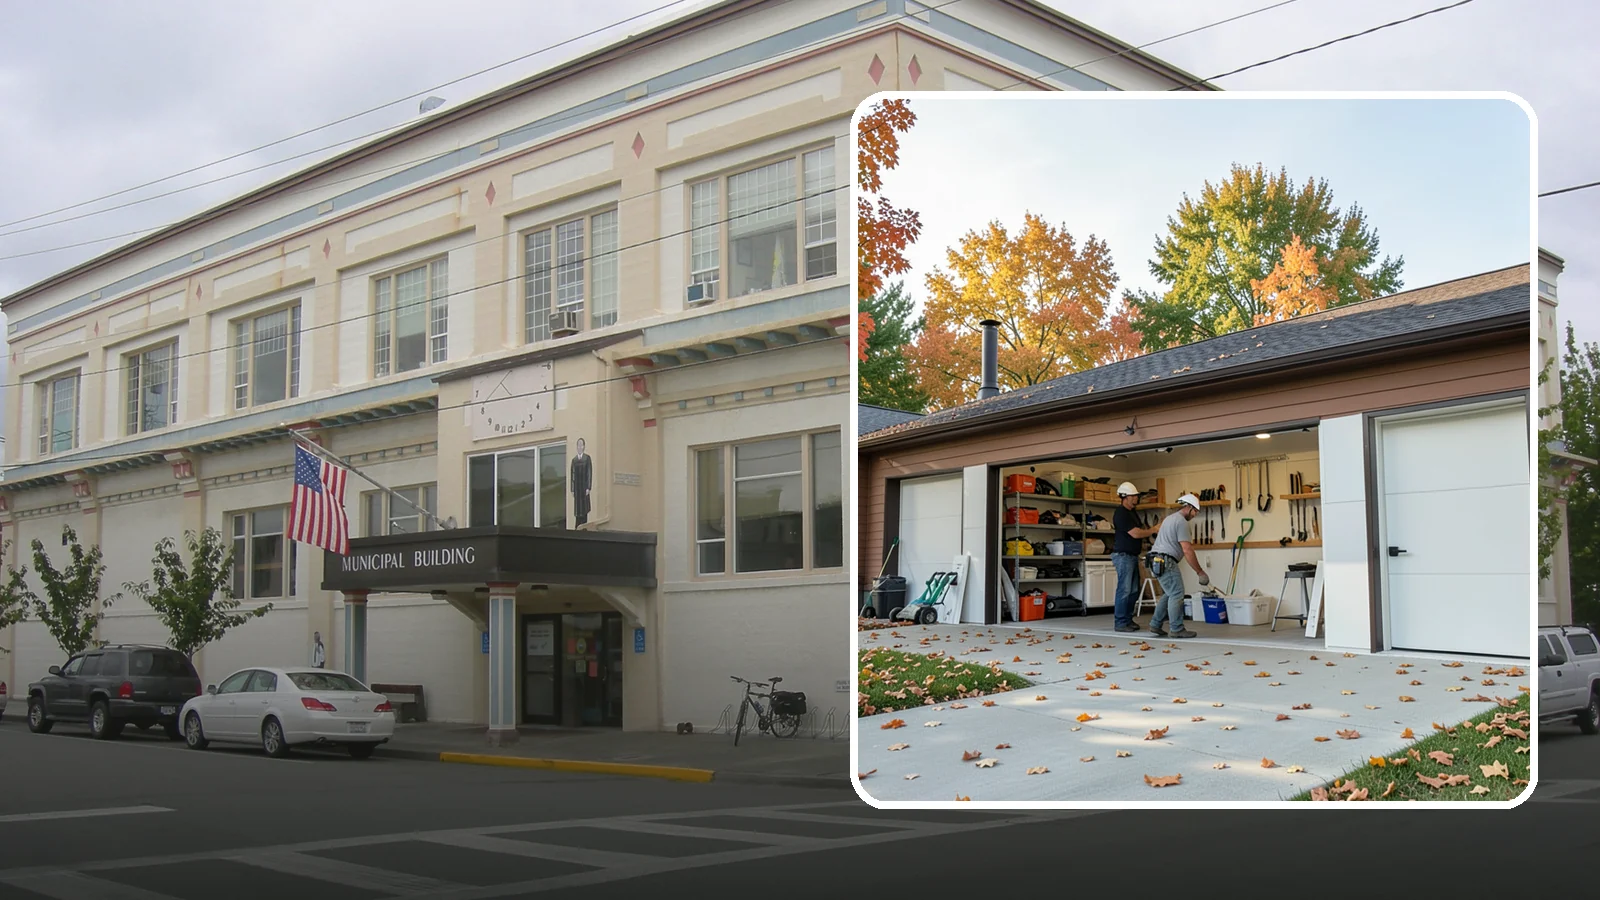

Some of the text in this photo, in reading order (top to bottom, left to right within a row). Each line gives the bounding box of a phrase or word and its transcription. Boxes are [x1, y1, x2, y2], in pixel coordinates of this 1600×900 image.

[508, 425, 513, 433] 12
[342, 546, 475, 572] MUNICIPAL BUILDING
